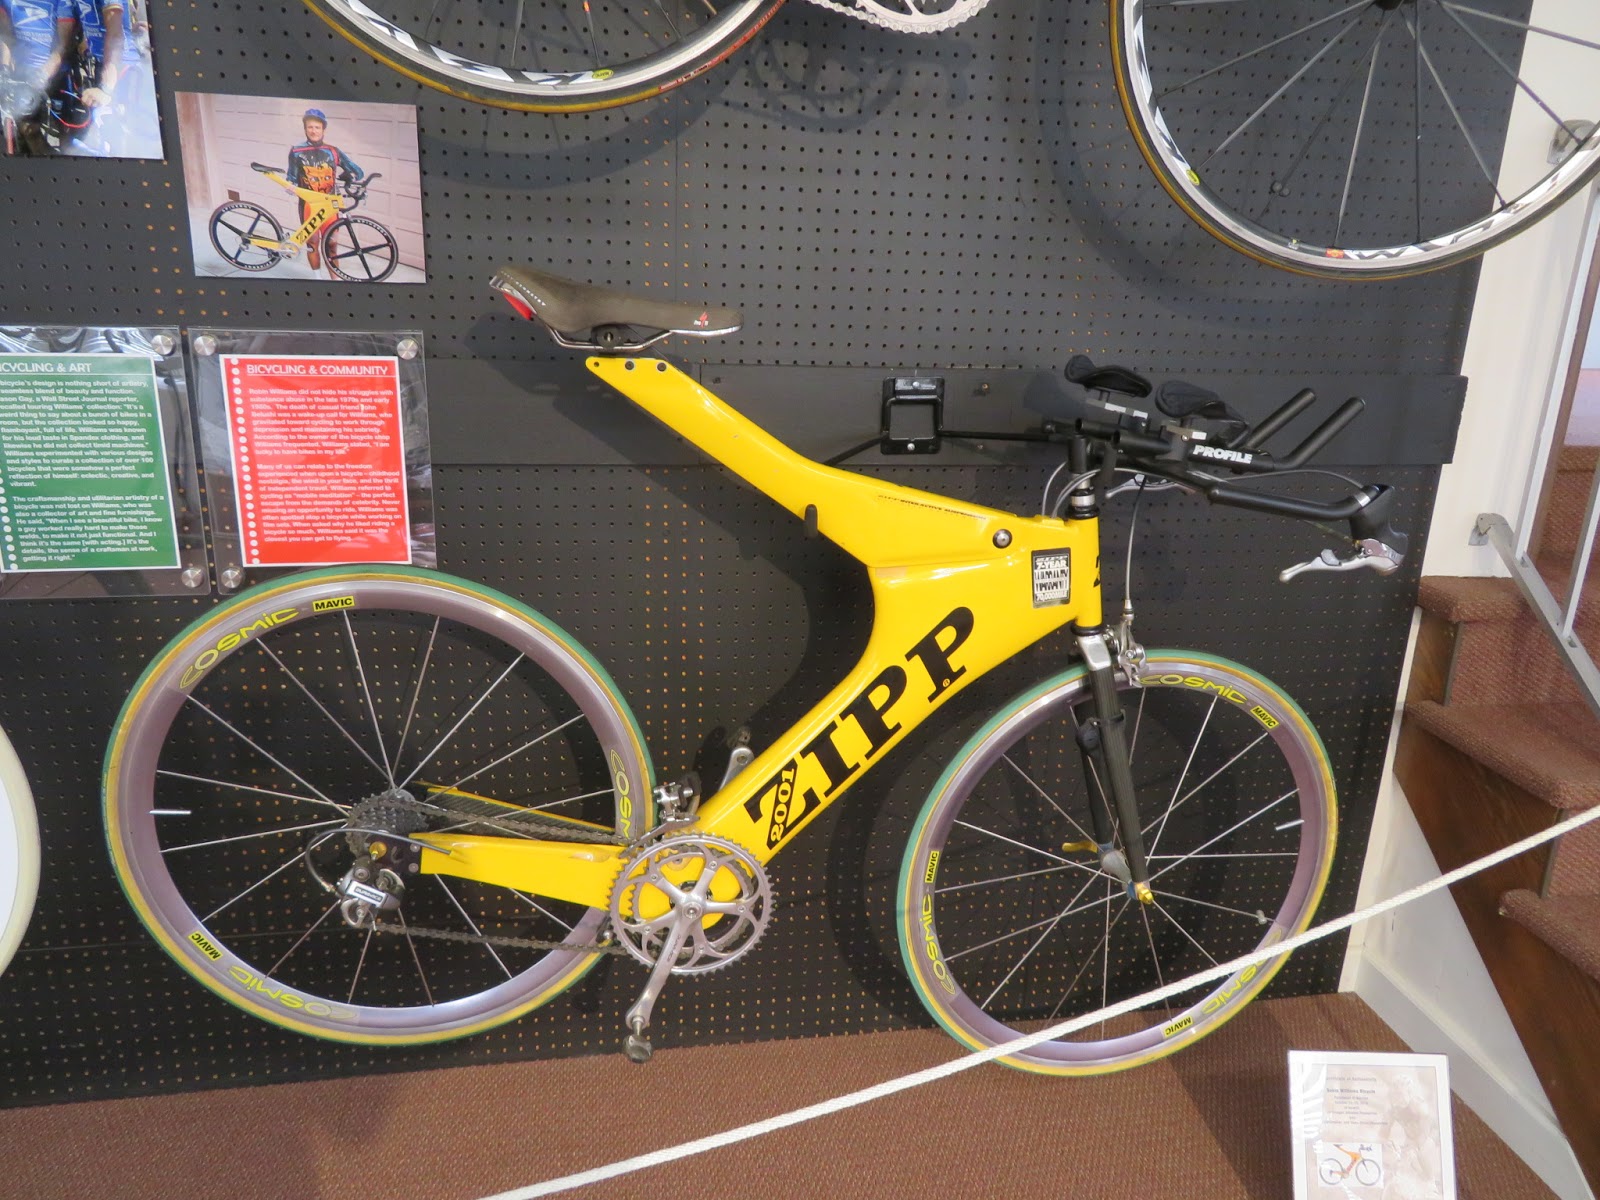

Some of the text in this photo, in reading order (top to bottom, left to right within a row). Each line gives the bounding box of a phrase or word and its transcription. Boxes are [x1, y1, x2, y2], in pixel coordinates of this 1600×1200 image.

[296, 208, 326, 243] ZIPP
[58, 363, 66, 372] &
[69, 363, 92, 372] ART
[247, 364, 388, 375] BICYCLING & COMMUNITY
[1193, 444, 1253, 465] PROFILE
[315, 598, 353, 610] MAVIC
[743, 606, 974, 850] ZIPP
[1252, 706, 1277, 729] MAVIC
[771, 768, 795, 842] 2001
[927, 852, 939, 882] MAVIC
[191, 933, 221, 960] MAVIC
[1165, 1017, 1192, 1036] MAVIC
